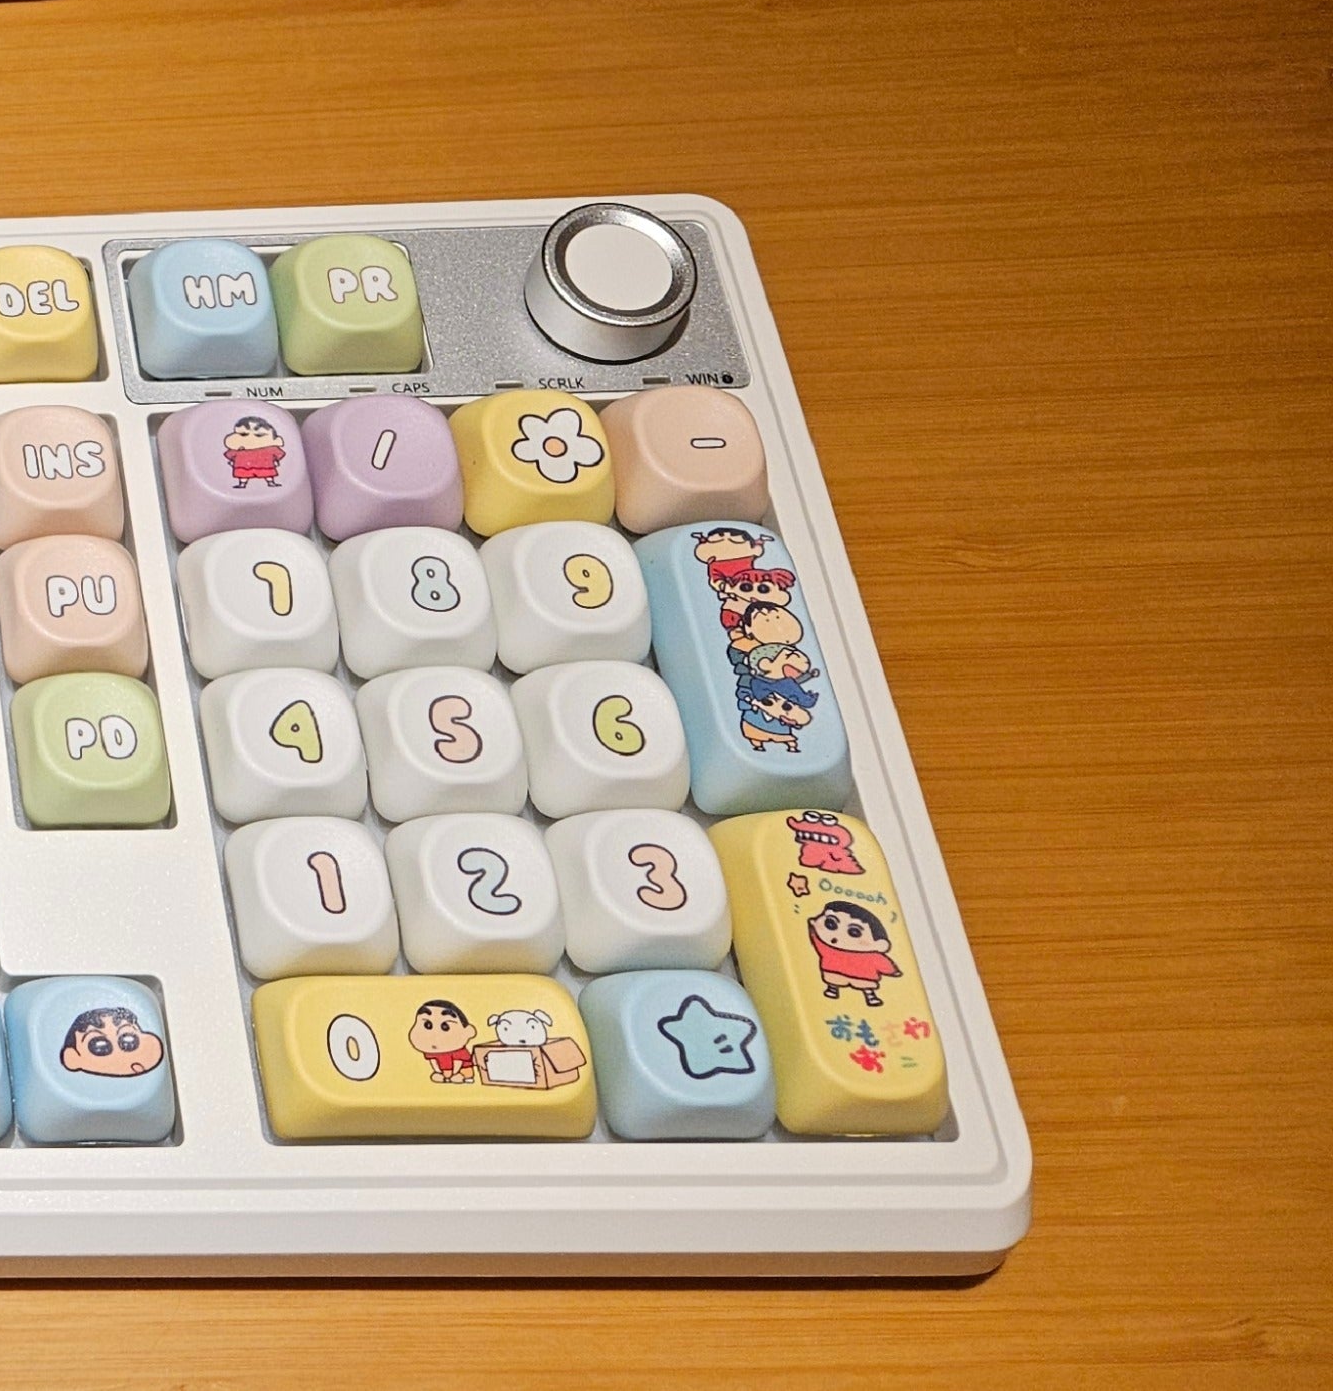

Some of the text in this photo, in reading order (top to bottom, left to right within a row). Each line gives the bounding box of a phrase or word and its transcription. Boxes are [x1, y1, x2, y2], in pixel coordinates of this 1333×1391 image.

[182, 271, 258, 309] HM
[327, 265, 399, 304] PR
[246, 385, 284, 397] NUM
[392, 382, 431, 395] CAPS
[538, 377, 585, 390] SCRLK
[685, 373, 719, 385] WIN
[22, 440, 106, 481] INS
[45, 574, 117, 618] PU
[411, 555, 461, 613] 8
[563, 553, 614, 610] 9
[64, 714, 138, 760] PD
[269, 699, 323, 764] 4
[428, 694, 483, 763] 5
[592, 694, 646, 757] 6
[306, 850, 347, 914] 1
[456, 846, 523, 916] 2
[627, 843, 688, 911] 3
